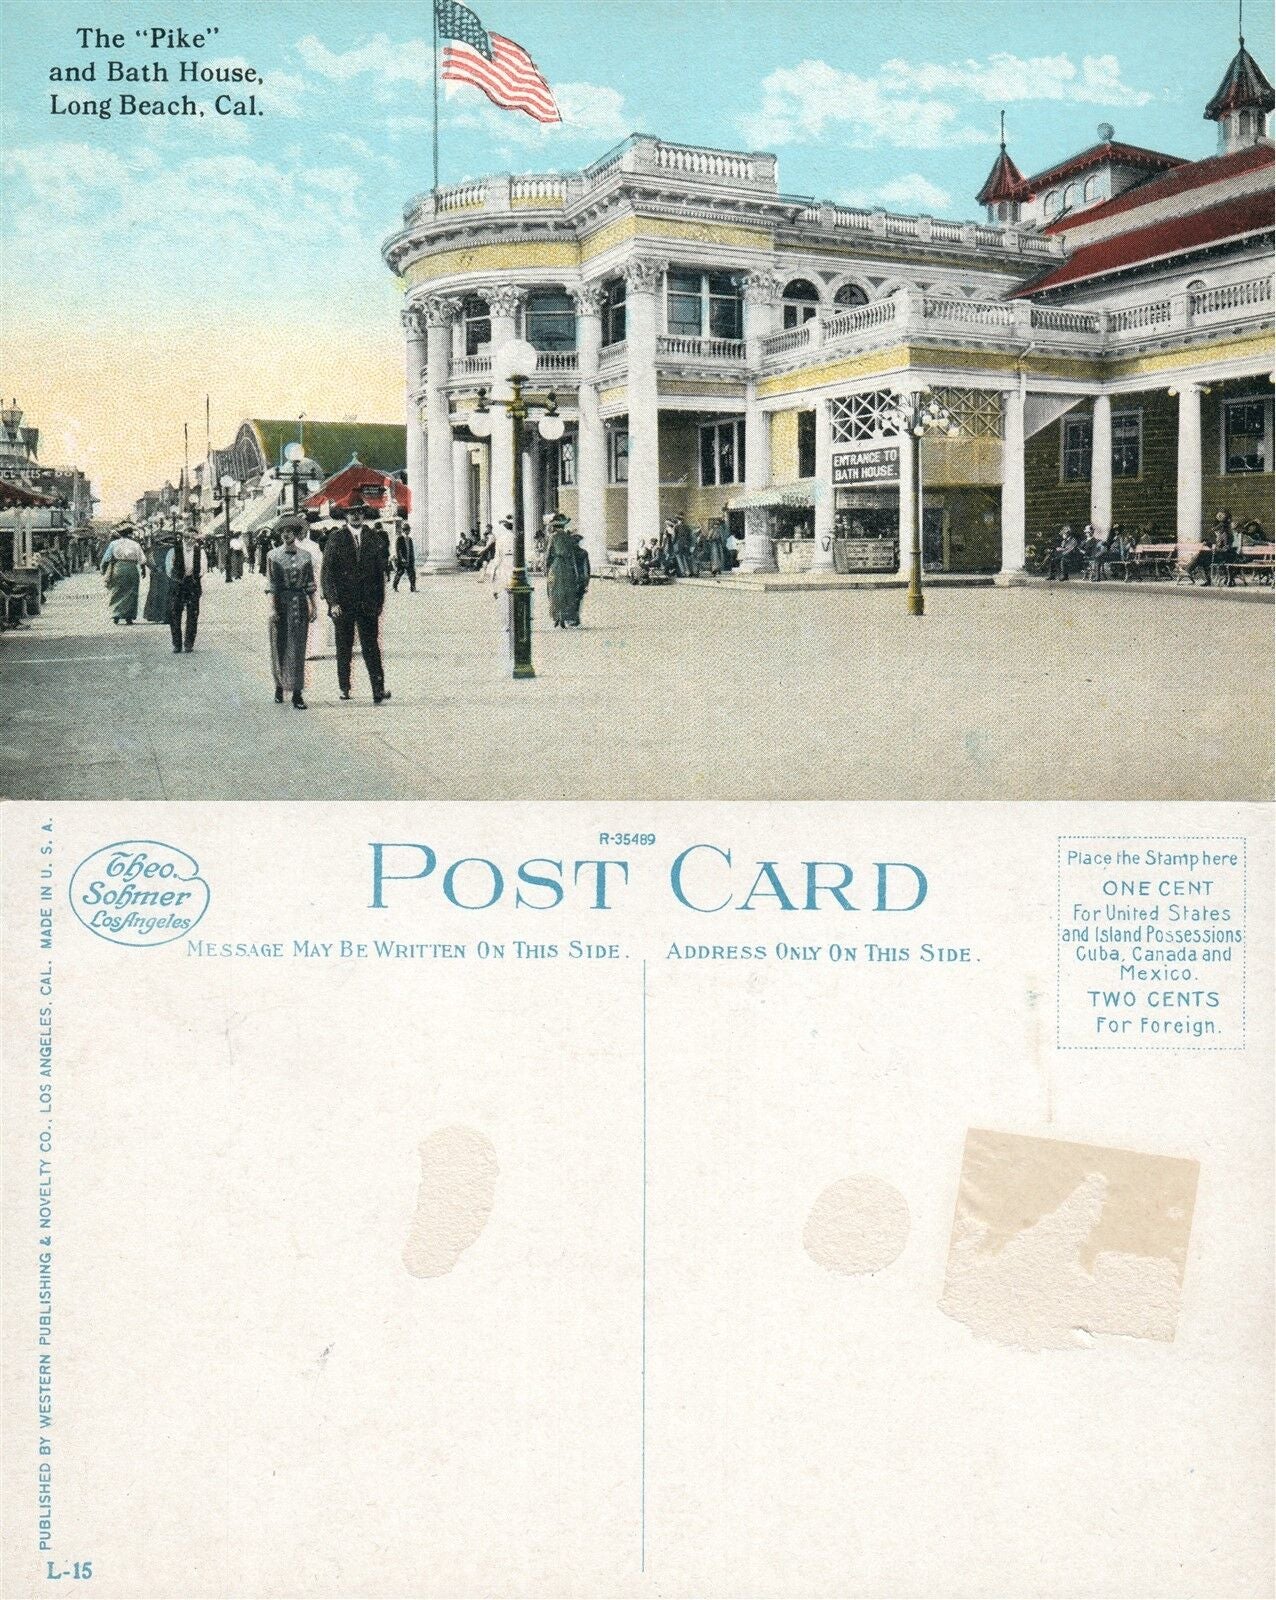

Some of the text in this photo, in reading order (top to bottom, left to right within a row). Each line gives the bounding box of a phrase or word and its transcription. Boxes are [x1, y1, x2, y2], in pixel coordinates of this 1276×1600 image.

[75, 27, 125, 49] The
[48, 60, 264, 85] and Bath House,
[50, 94, 264, 120] Long Beach, Cal.
[833, 449, 897, 467] ENTRANCE TO
[835, 464, 898, 481] BATH HOUSE.
[41, 818, 52, 833] A.
[41, 840, 52, 855] S.
[599, 832, 657, 846] R-35489
[106, 852, 178, 882] Theo.
[1067, 849, 1238, 872] Place the Stamp here
[41, 863, 52, 879] U.
[41, 886, 52, 901] IN
[82, 881, 192, 909] Sohmer
[1102, 880, 1214, 897] ONE CENT
[1073, 903, 1231, 922] For United States
[41, 908, 52, 949] MADE
[1061, 924, 1243, 944] and Island Possessions
[1076, 945, 1232, 963] Cuba, Canada and
[40, 960, 51, 996] CAL.
[1120, 963, 1198, 981] Mexico.
[1087, 990, 1220, 1008] TWO CENTS
[1096, 1015, 1222, 1038] For Foreign.
[40, 1084, 51, 1113] LOS
[40, 1159, 51, 1229] NOVELTY
[40, 1235, 51, 1247] &
[39, 1252, 51, 1346] PUBLISHING
[39, 1354, 51, 1429] WESTERN
[39, 1436, 51, 1456] BY
[39, 1462, 51, 1551] PUBLISHED
[46, 1560, 93, 1580] L-15
